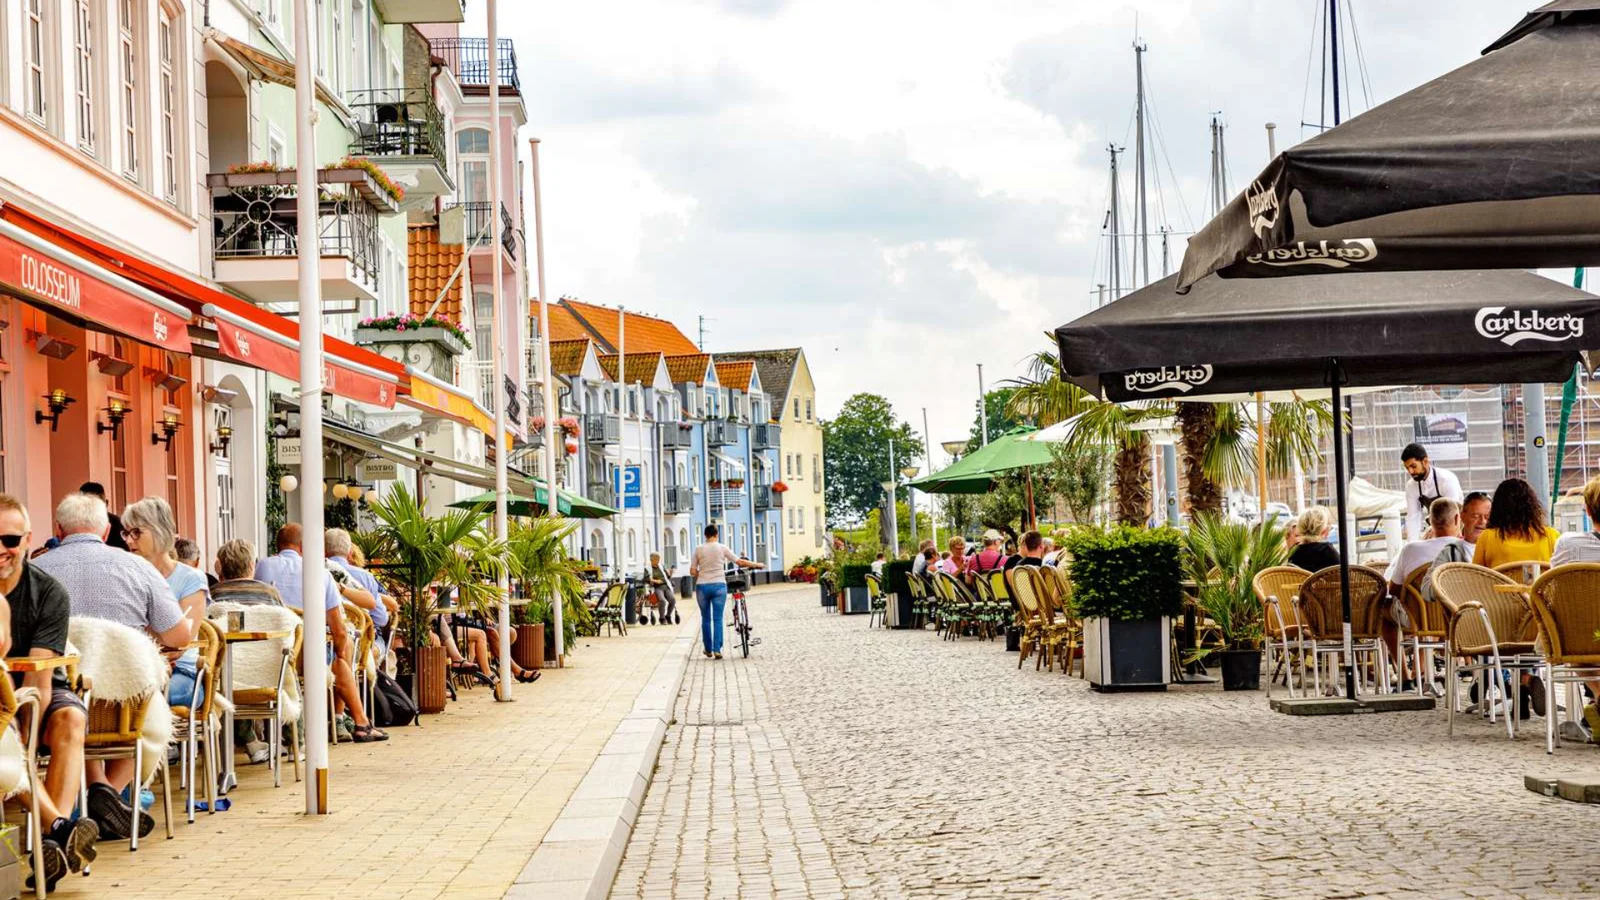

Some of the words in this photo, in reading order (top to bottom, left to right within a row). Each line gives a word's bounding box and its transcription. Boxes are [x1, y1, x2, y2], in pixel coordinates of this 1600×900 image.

[1245, 180, 1280, 239] Carlsberg
[21, 254, 80, 308] COLOSSEUM
[1475, 306, 1584, 346] Carlsberg
[282, 445, 301, 453] BIST
